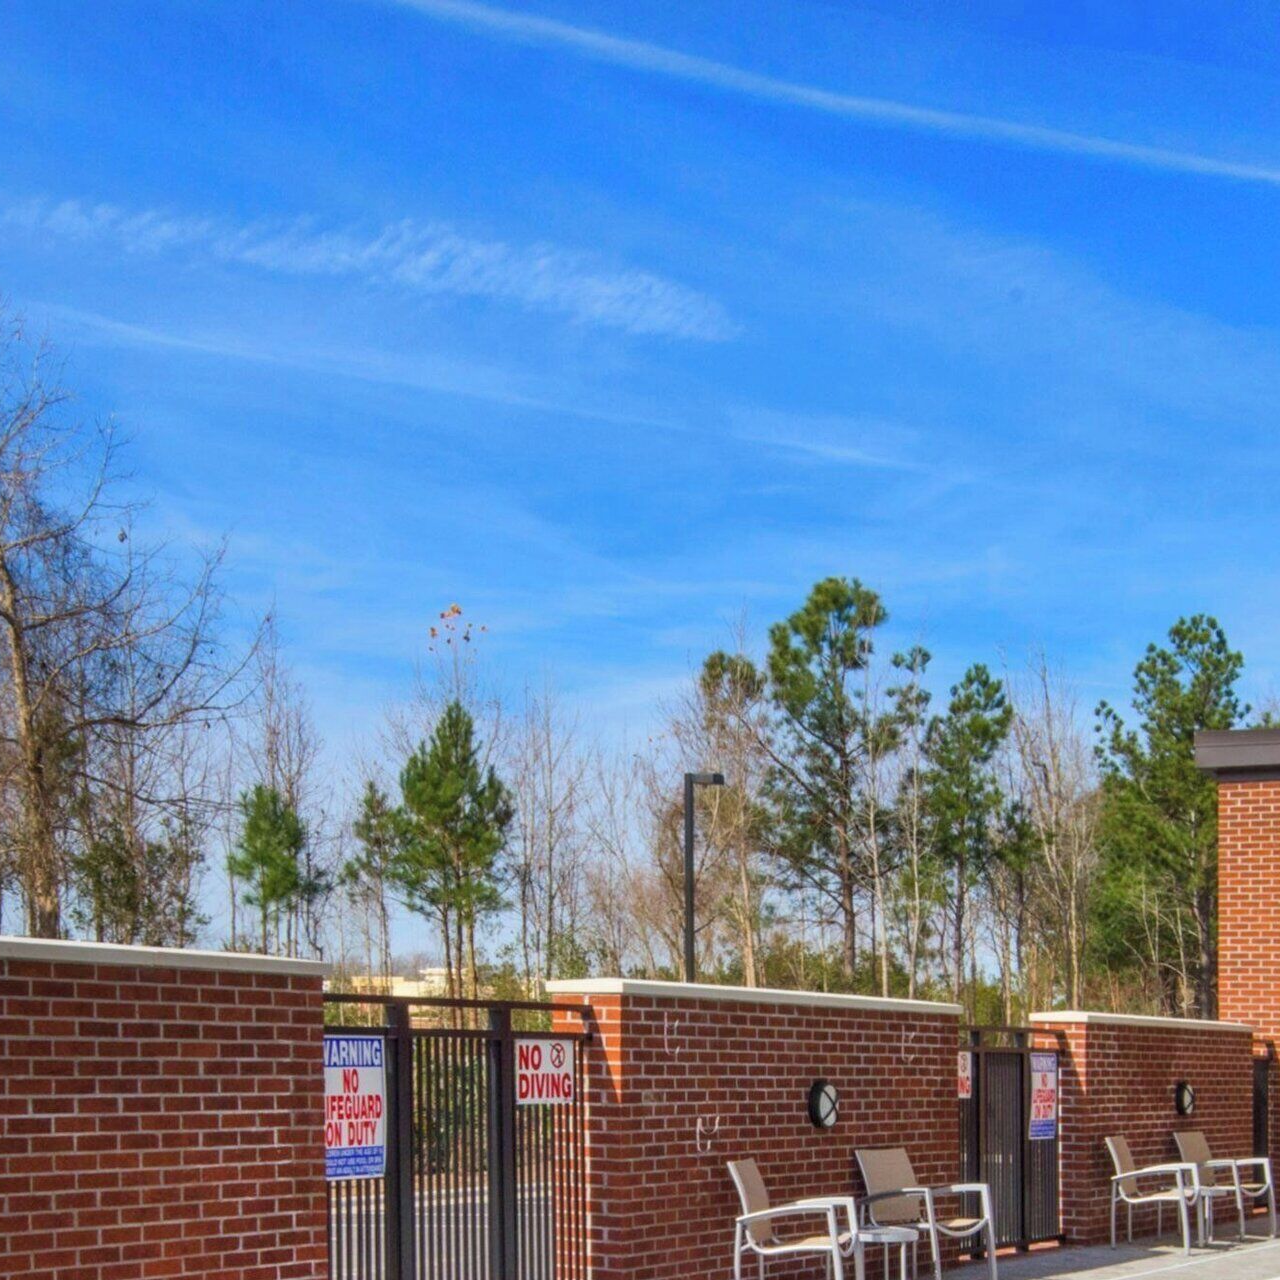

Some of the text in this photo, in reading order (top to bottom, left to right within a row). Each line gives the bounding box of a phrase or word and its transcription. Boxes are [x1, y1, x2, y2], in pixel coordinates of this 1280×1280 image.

[519, 1044, 542, 1070] NO
[343, 1069, 359, 1093] NO
[519, 1072, 572, 1099] DIVING
[326, 1095, 382, 1120] IFEGUARD
[326, 1121, 377, 1147] ON DUTY
